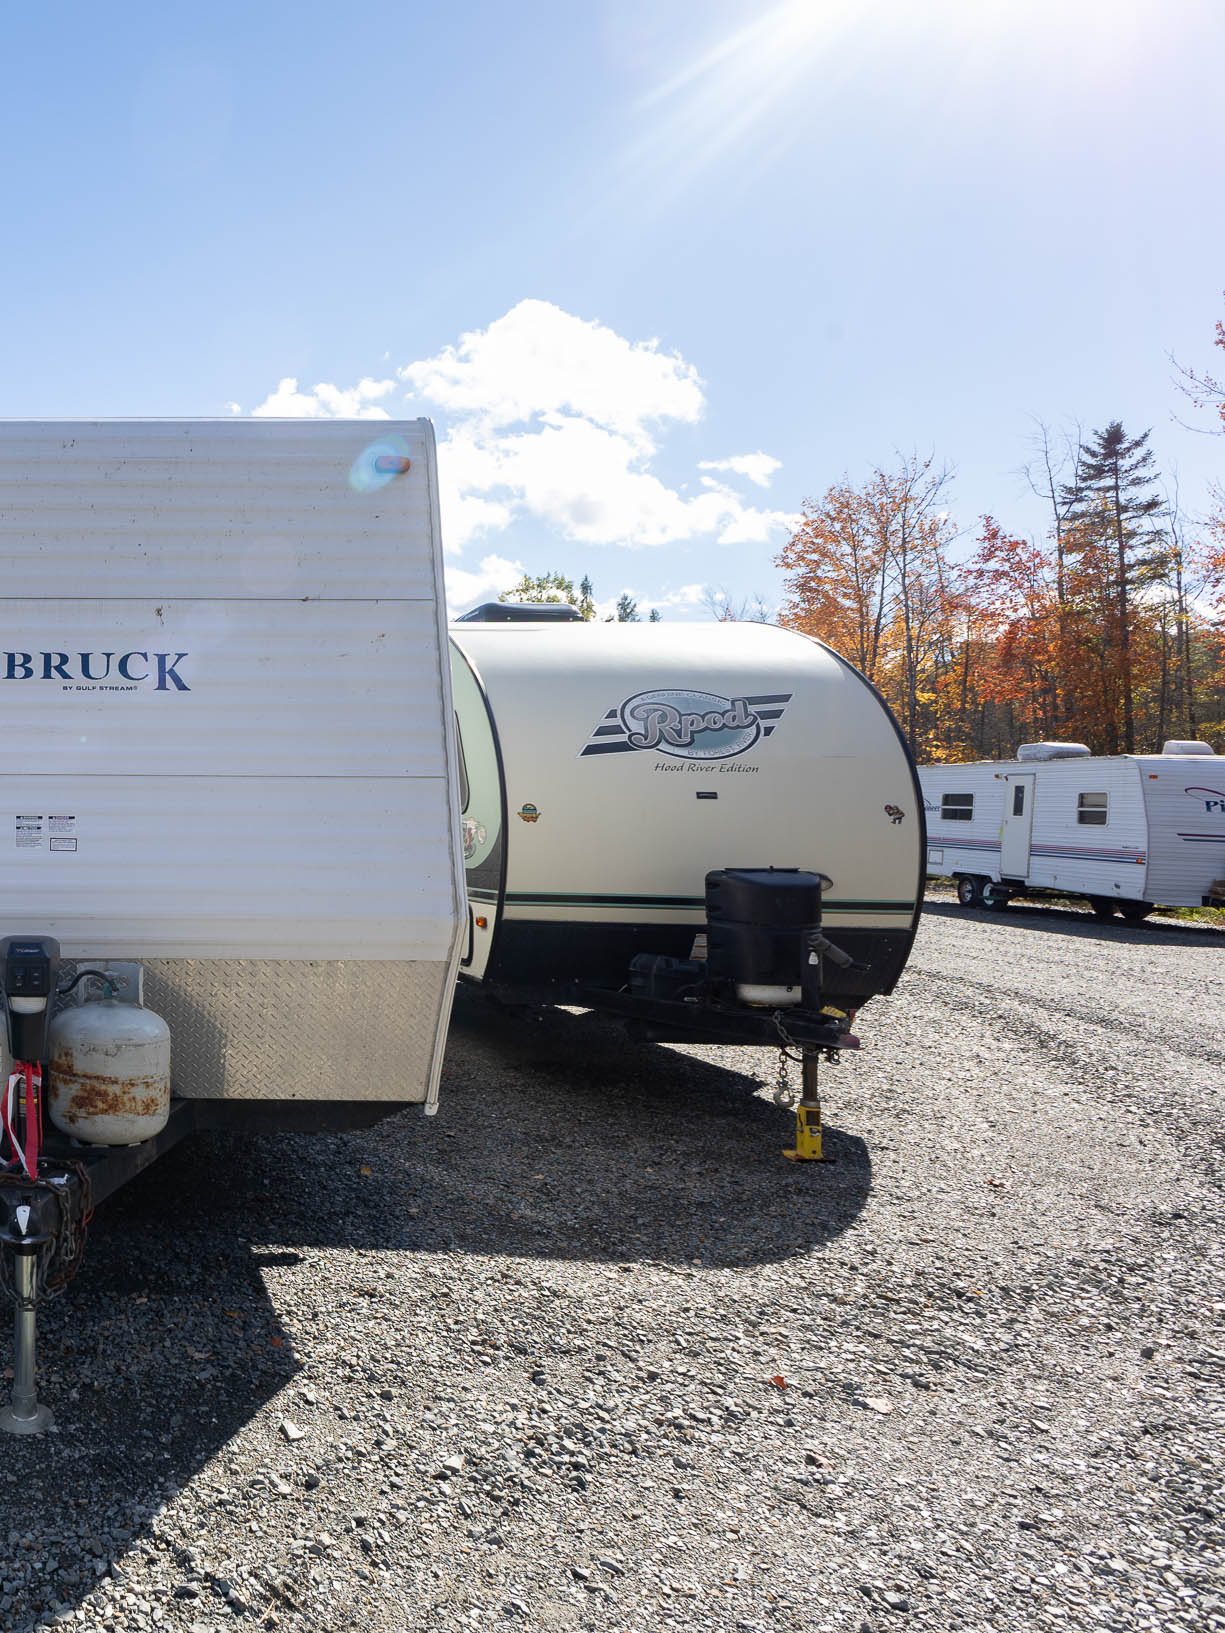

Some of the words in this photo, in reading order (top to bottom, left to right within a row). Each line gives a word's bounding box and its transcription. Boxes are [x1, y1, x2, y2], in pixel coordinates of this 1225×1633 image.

[654, 762, 685, 772] Hood
[687, 762, 716, 772] River
[719, 762, 759, 773] Edition
